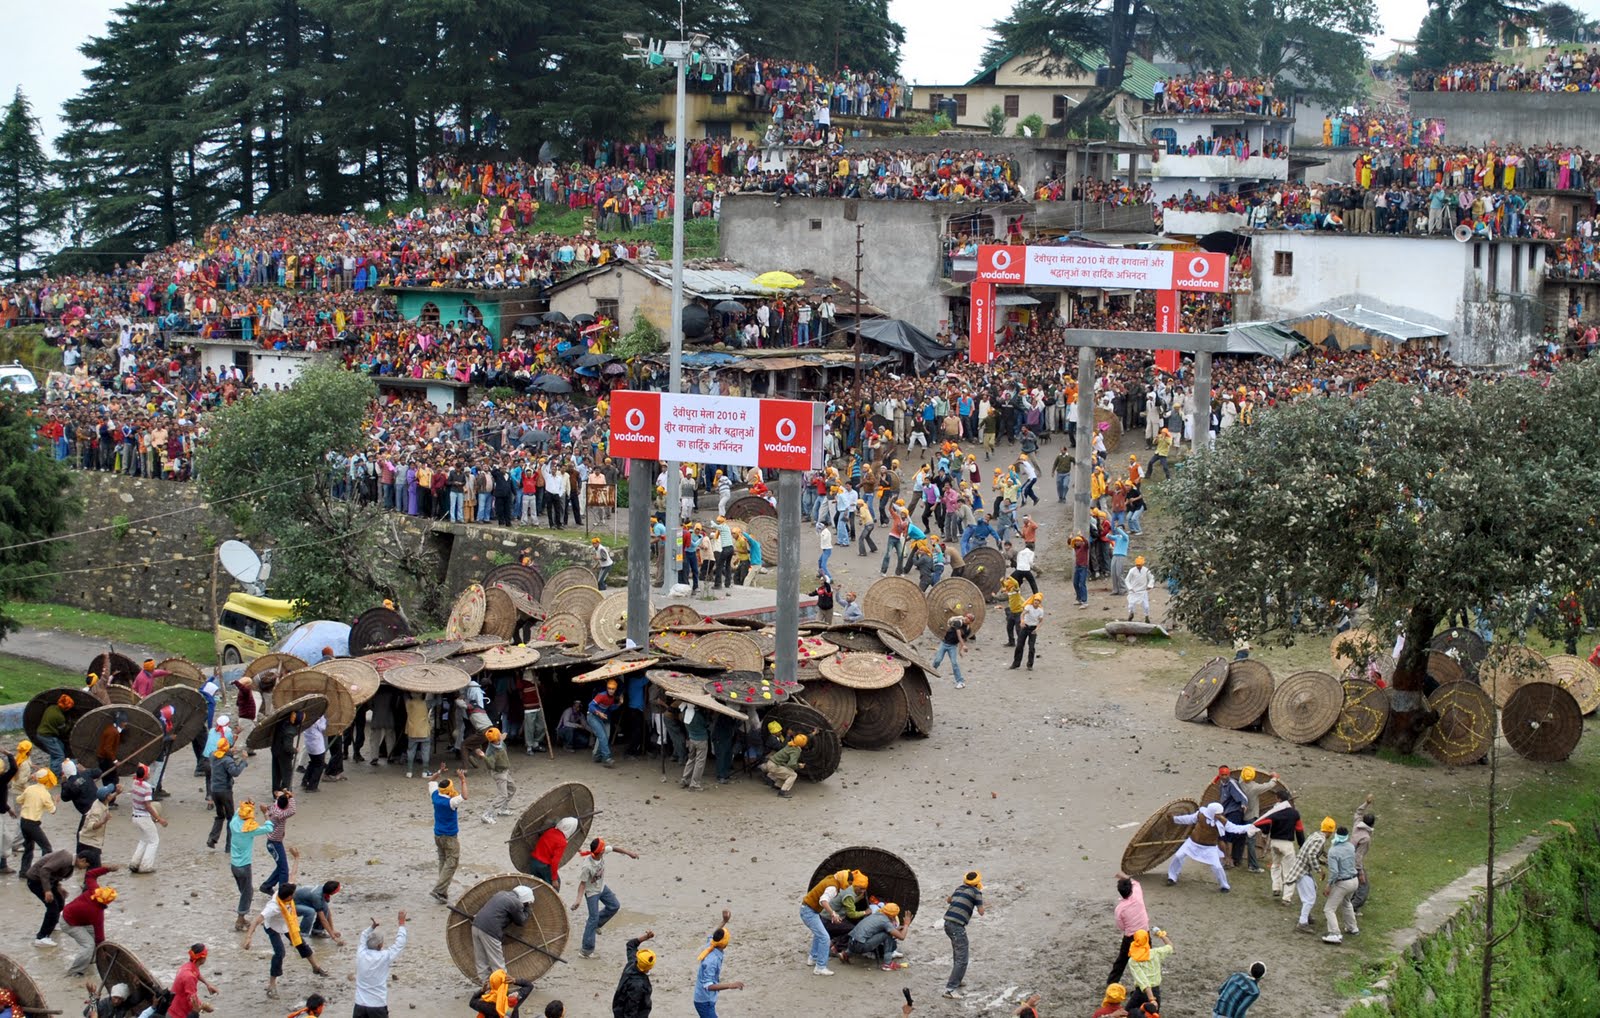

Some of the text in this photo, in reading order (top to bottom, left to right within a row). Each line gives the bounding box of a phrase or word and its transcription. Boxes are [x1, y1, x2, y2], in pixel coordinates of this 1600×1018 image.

[1061, 254, 1074, 264] मेला
[1077, 256, 1096, 264] 2010
[1107, 255, 1119, 265] वीर
[1152, 257, 1164, 267] और
[981, 272, 1020, 280] vodafone
[1093, 269, 1113, 279] हार्दिक
[1117, 270, 1146, 280] अभिनंदन
[1177, 279, 1219, 288] vodafone
[673, 406, 697, 420] देवीधुरा
[700, 408, 714, 419] मेला
[717, 411, 737, 420] 2010
[664, 421, 754, 440] वीर बगवालों और श्रद्धालुओं
[614, 432, 655, 443] vodafone
[677, 440, 686, 448] का
[713, 440, 743, 452] अभिनंदन
[764, 443, 806, 454] vodafone
